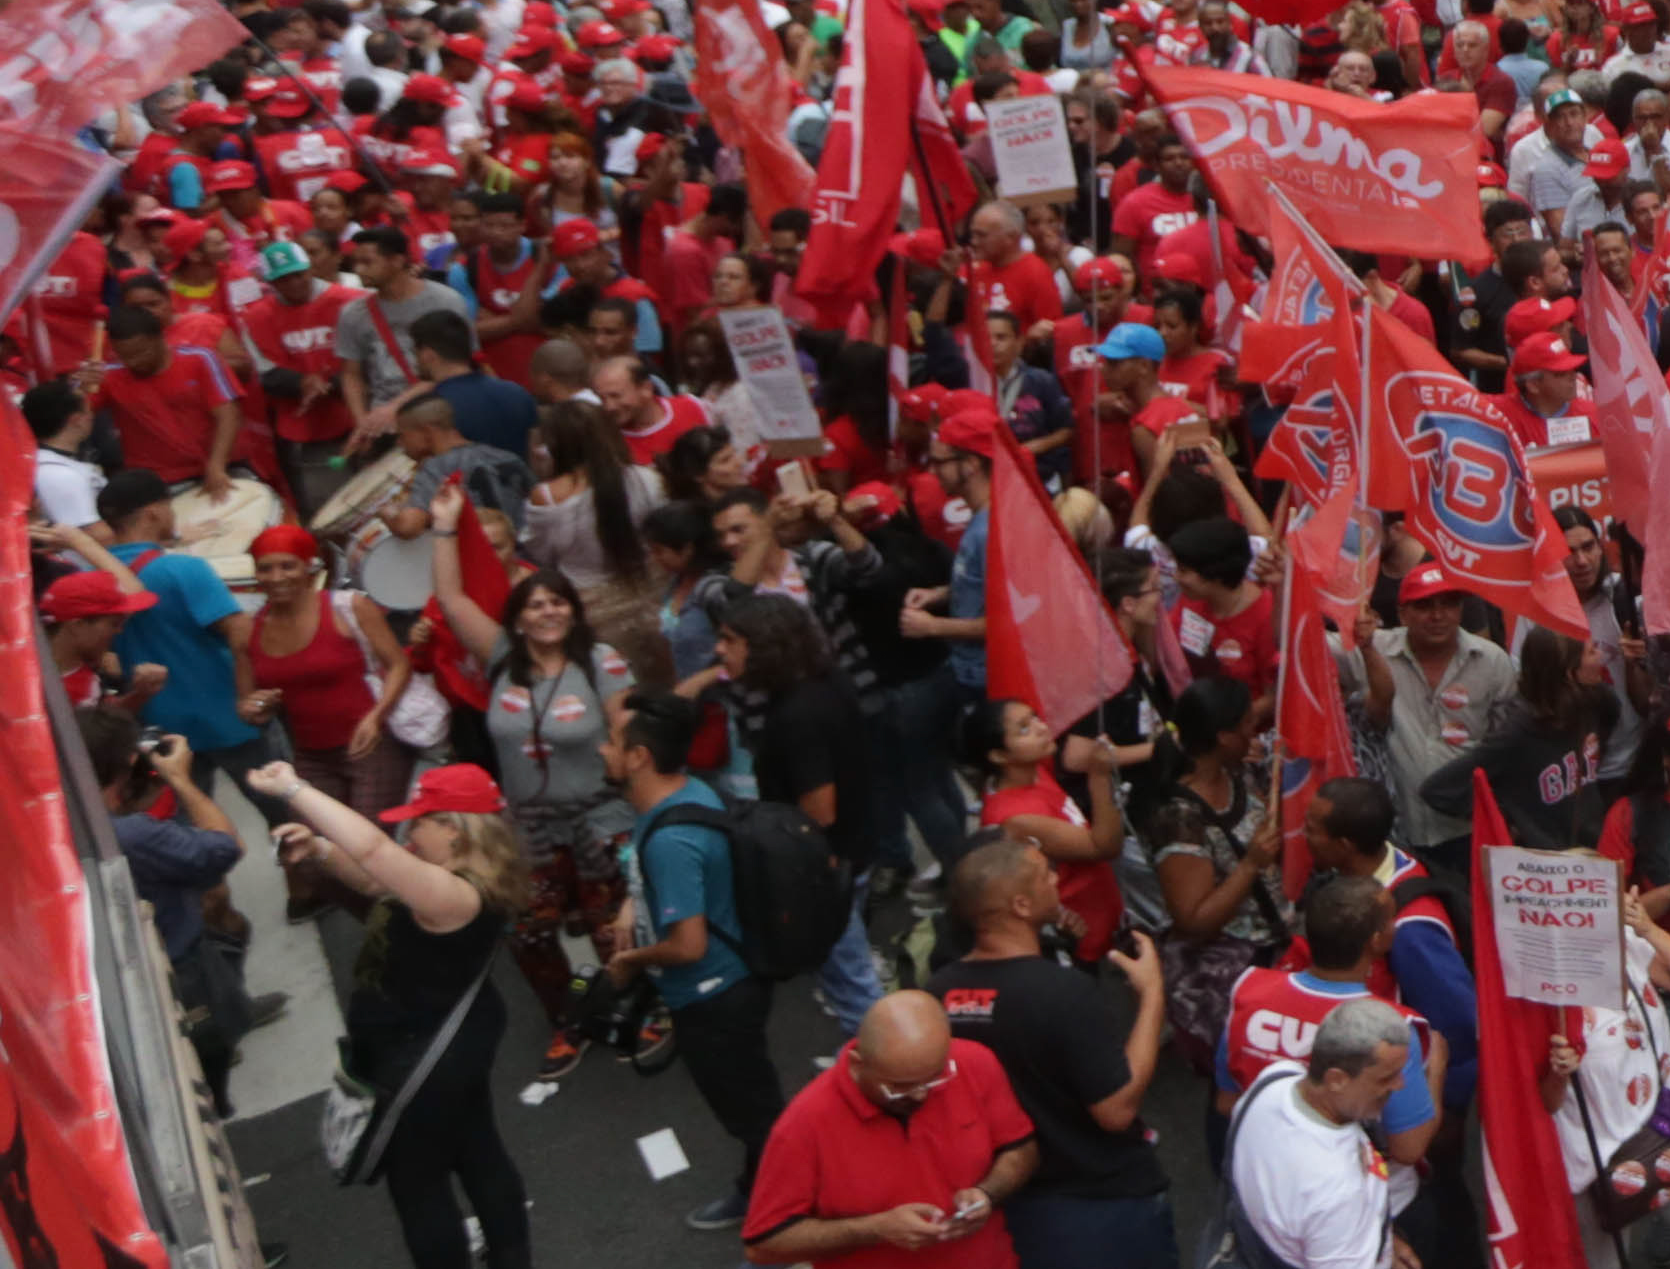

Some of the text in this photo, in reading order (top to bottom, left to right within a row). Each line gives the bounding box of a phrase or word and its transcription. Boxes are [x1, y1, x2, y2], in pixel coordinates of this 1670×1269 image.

[1170, 93, 1444, 200] Dilma
[1517, 861, 1570, 876] ABAIXO
[1500, 875, 1610, 897] GOLPE
[1541, 982, 1578, 995] PCO
[1244, 1009, 1321, 1052] CU
